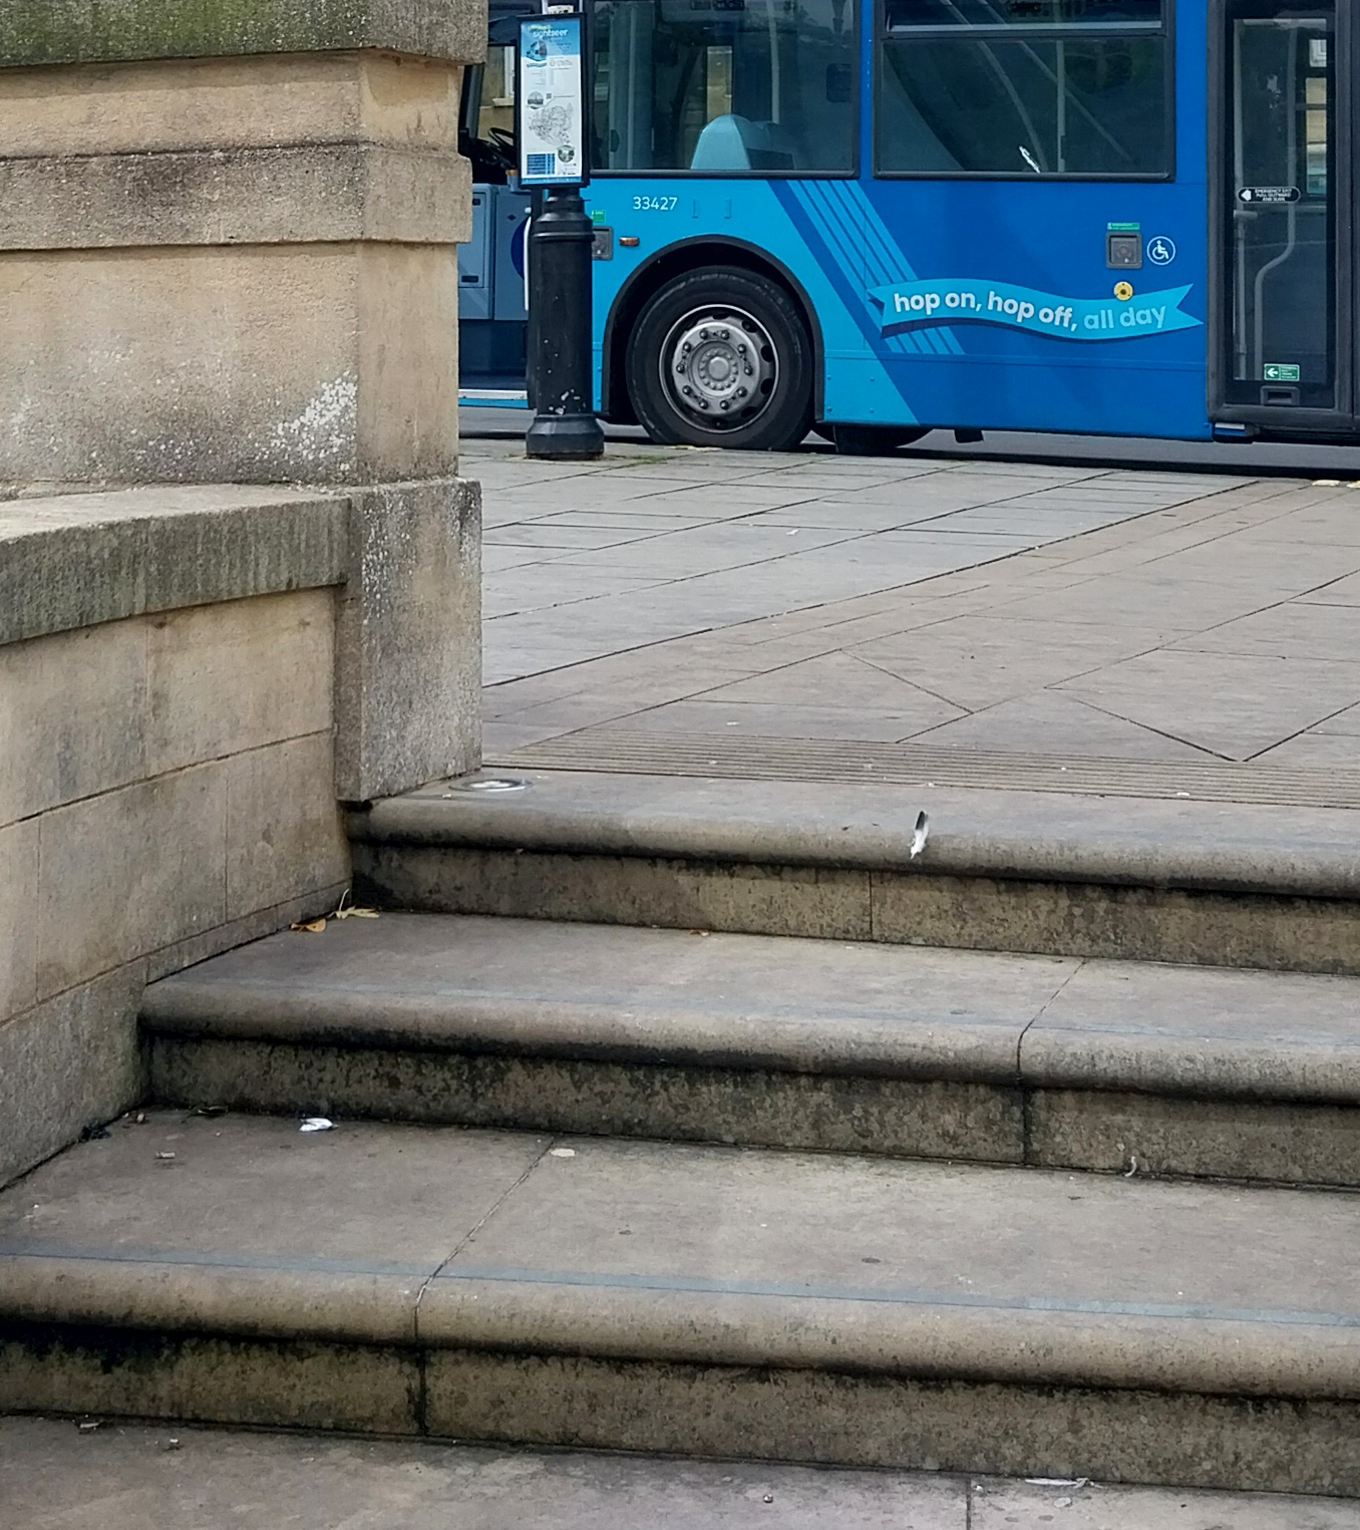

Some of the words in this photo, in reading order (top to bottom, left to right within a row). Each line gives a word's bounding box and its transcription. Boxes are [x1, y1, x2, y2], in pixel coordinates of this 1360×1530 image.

[633, 196, 678, 210] 33427
[894, 292, 940, 315] hop
[944, 290, 982, 312] on,
[987, 290, 1035, 323] hop
[1038, 304, 1078, 332] off,
[1084, 309, 1114, 329] all
[1119, 305, 1166, 329] day
